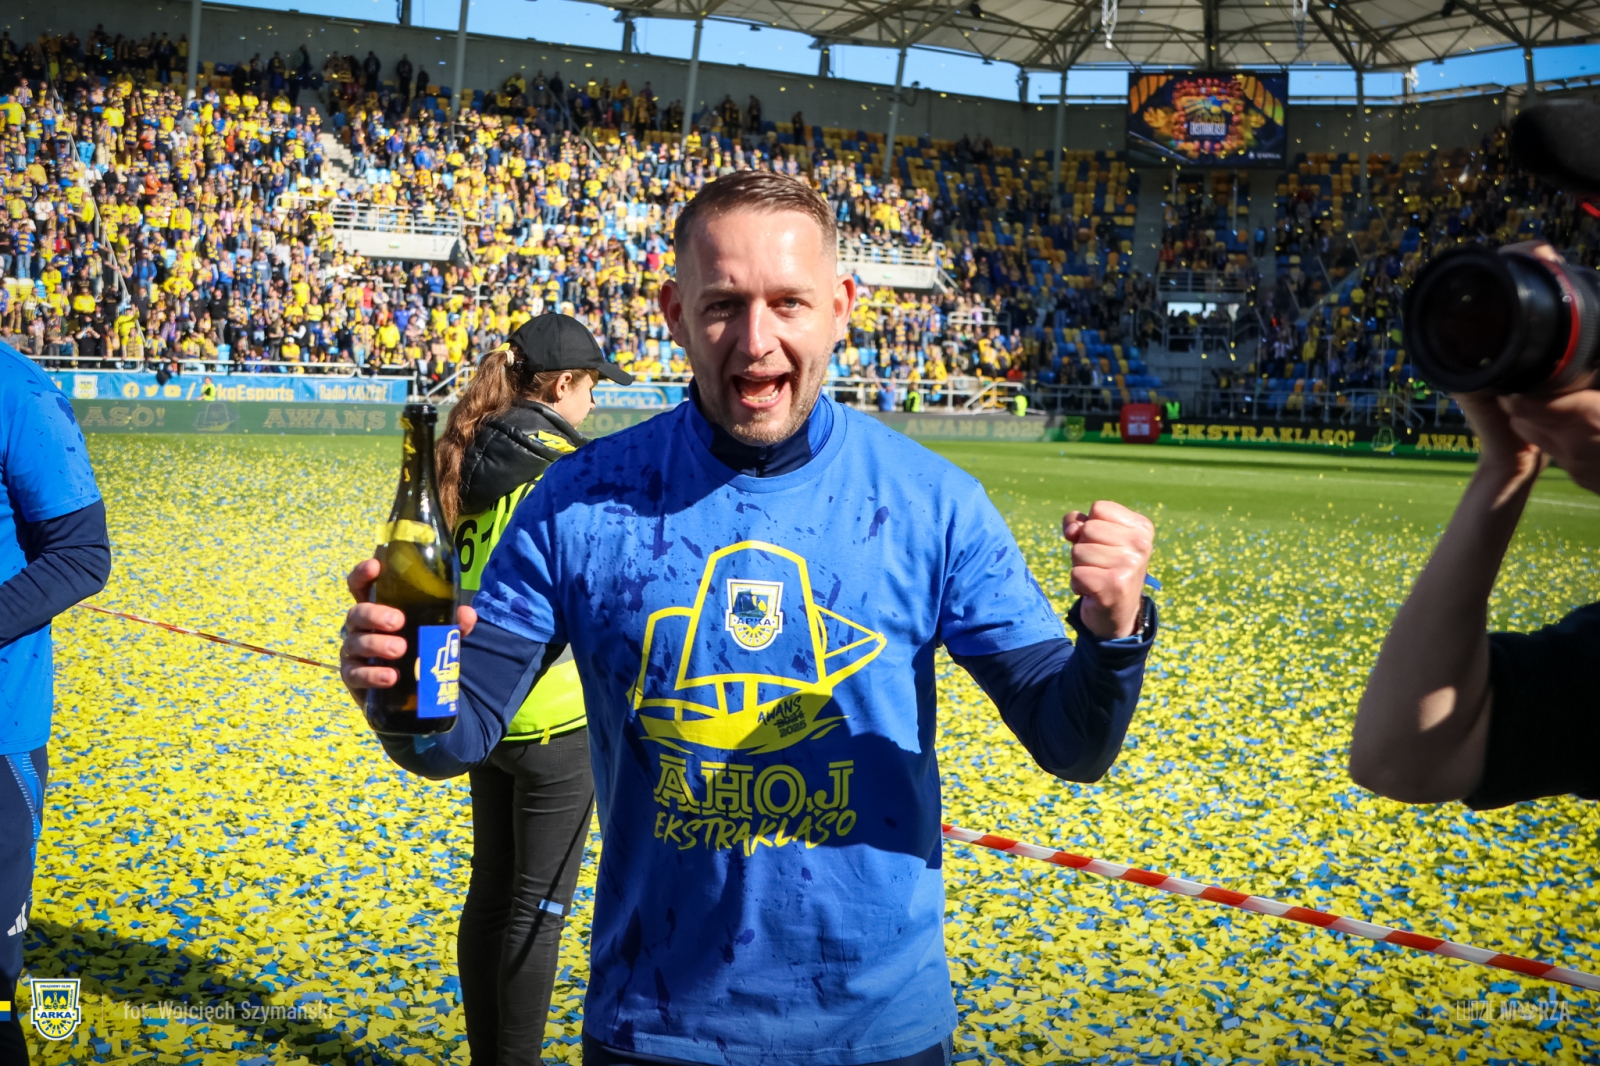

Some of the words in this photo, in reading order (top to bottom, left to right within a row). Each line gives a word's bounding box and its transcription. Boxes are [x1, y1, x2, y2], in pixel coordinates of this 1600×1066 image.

[81, 405, 166, 427] ASO!
[262, 408, 387, 430] AWANS
[903, 419, 989, 437] AWANS
[993, 420, 1045, 438] 2025
[1414, 433, 1484, 453] AWAN
[757, 695, 802, 726] AWANS
[653, 753, 855, 821] AHOJ
[653, 804, 858, 858] EKSTRAKLASO
